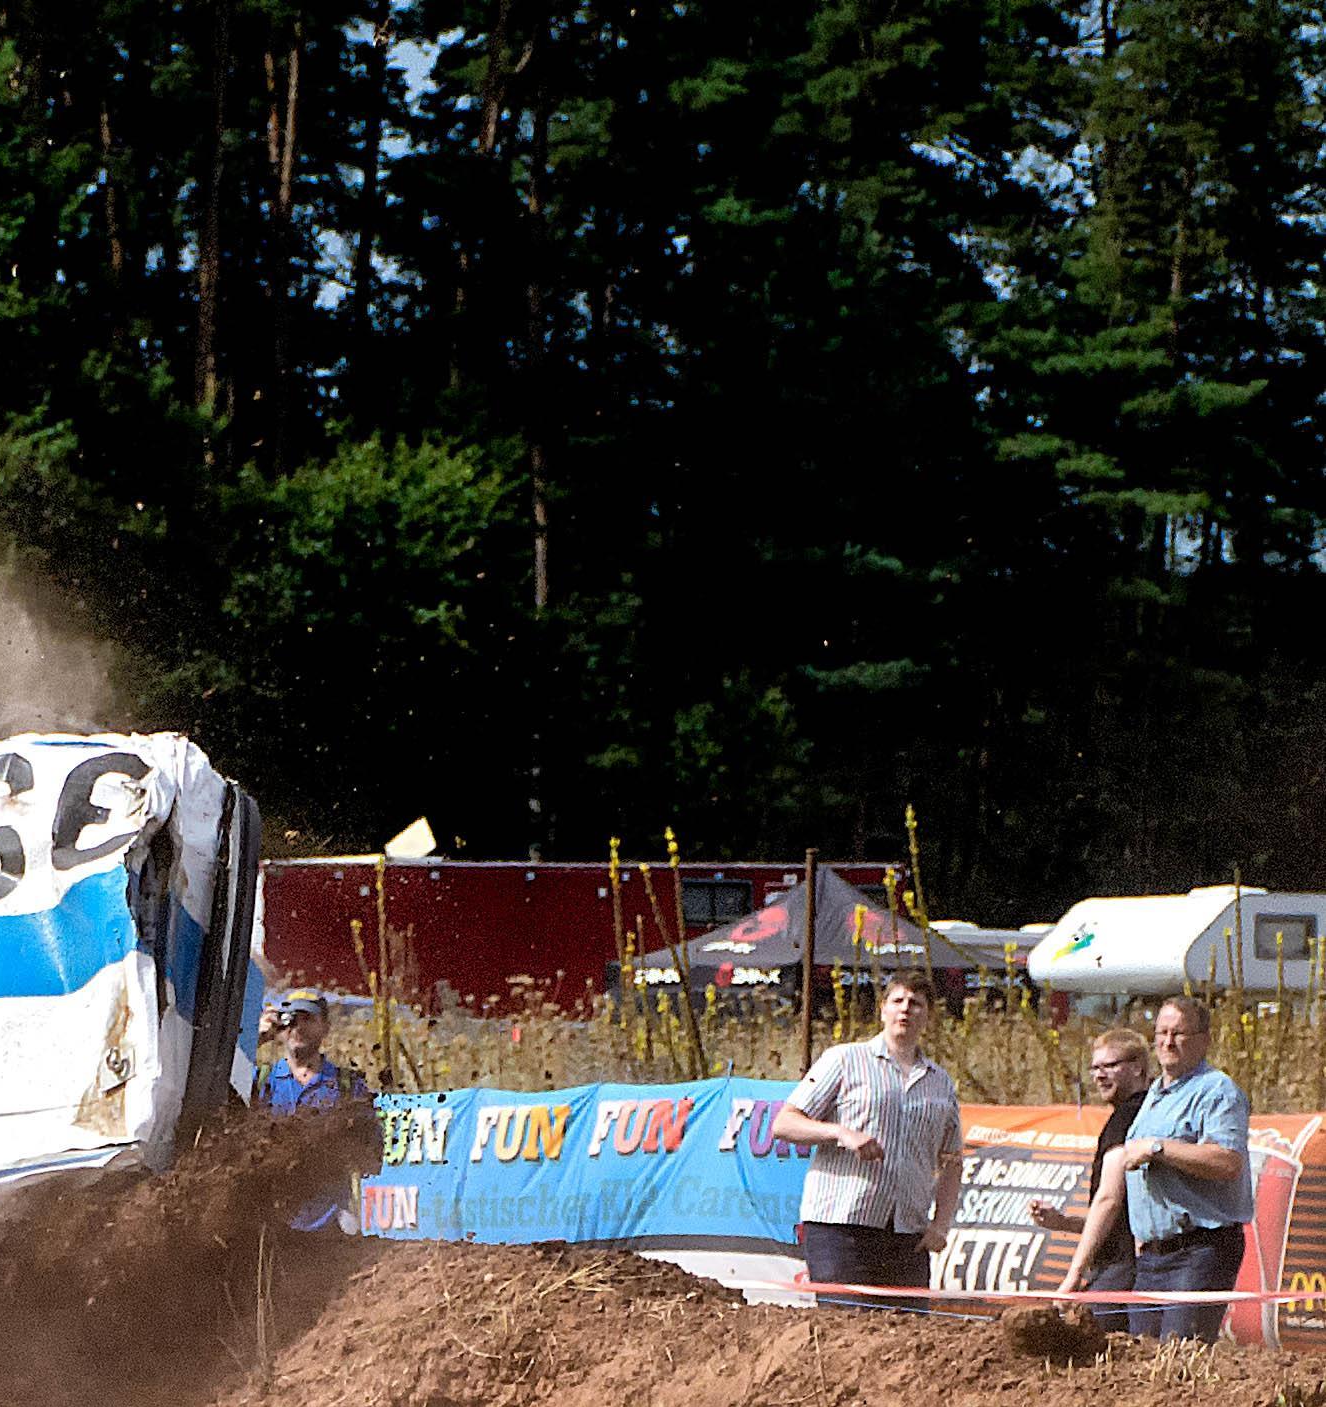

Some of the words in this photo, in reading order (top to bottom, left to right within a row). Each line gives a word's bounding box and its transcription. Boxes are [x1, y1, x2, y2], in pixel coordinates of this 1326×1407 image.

[378, 1105, 454, 1165] UN
[469, 1103, 572, 1163] FUN
[587, 1097, 695, 1157] FUN
[717, 1098, 812, 1158] FU
[955, 1188, 1066, 1227] SEKUNDN
